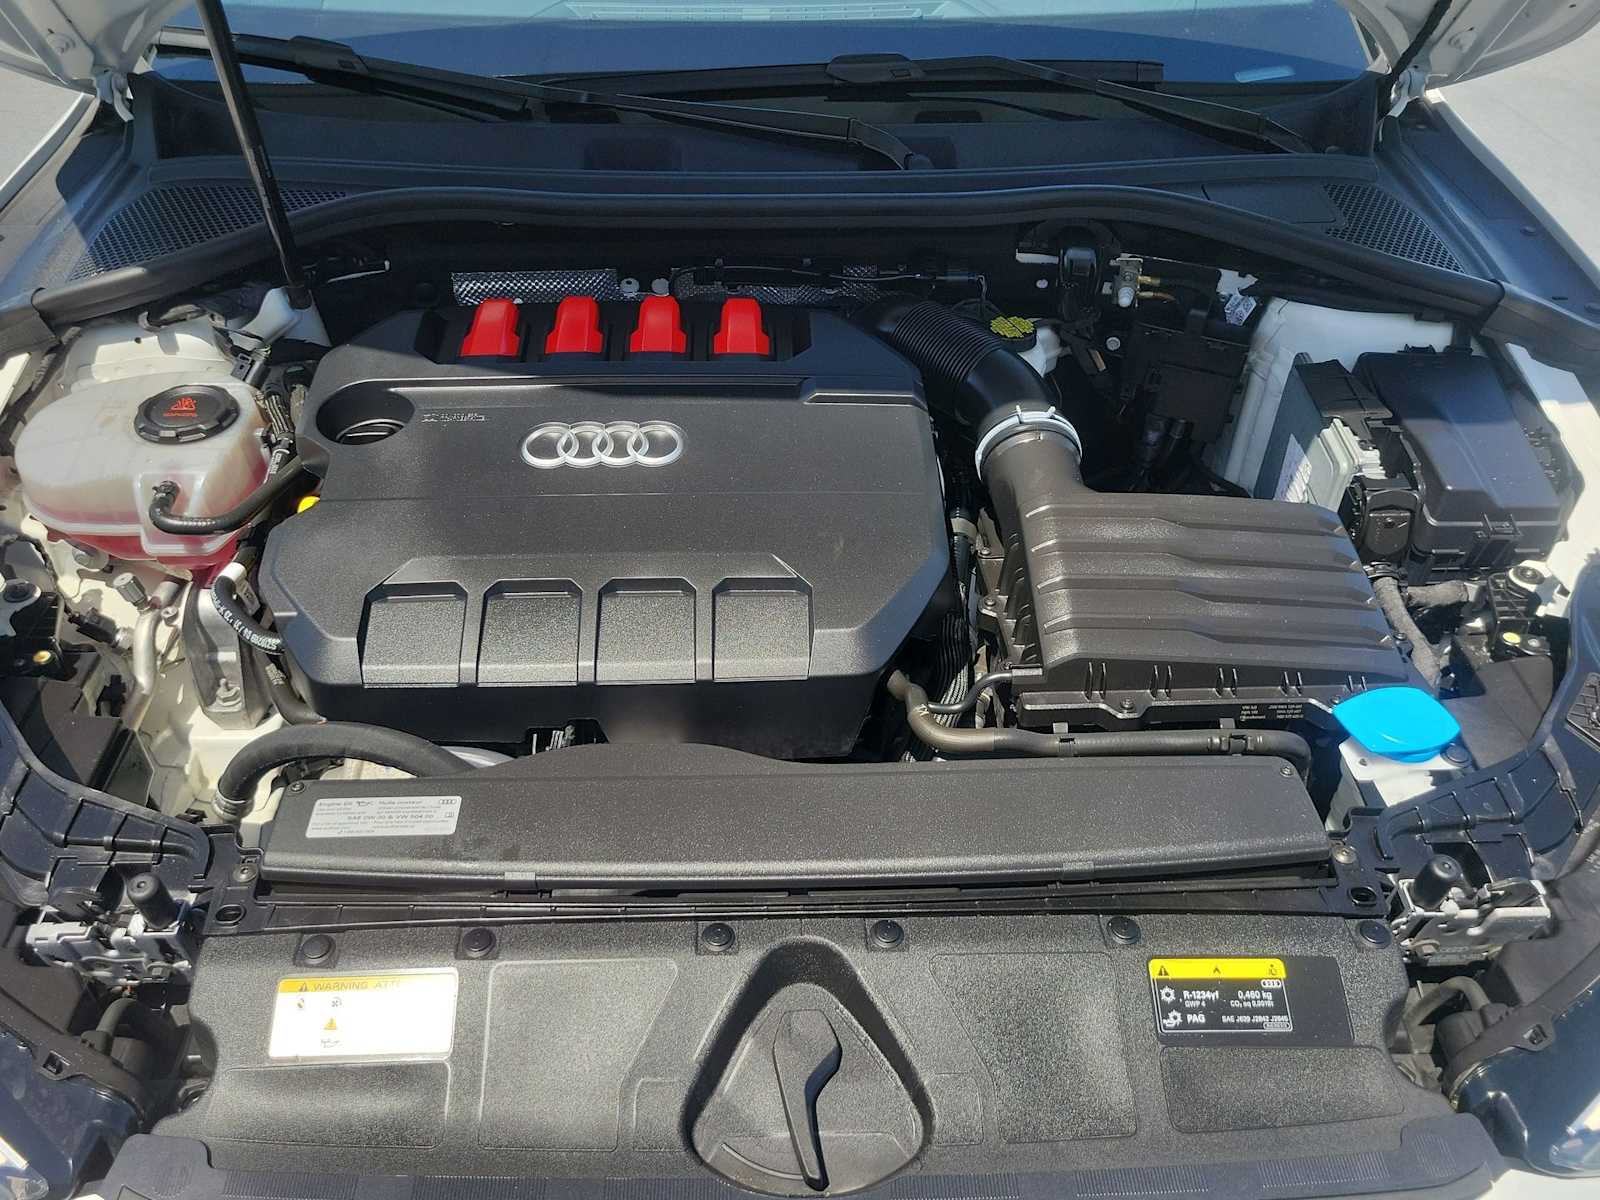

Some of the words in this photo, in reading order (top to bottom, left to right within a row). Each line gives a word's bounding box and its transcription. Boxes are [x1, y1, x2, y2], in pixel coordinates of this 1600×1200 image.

[314, 981, 369, 992] WARNING
[1261, 990, 1273, 1001] kg
[1186, 1013, 1206, 1024] PAG
